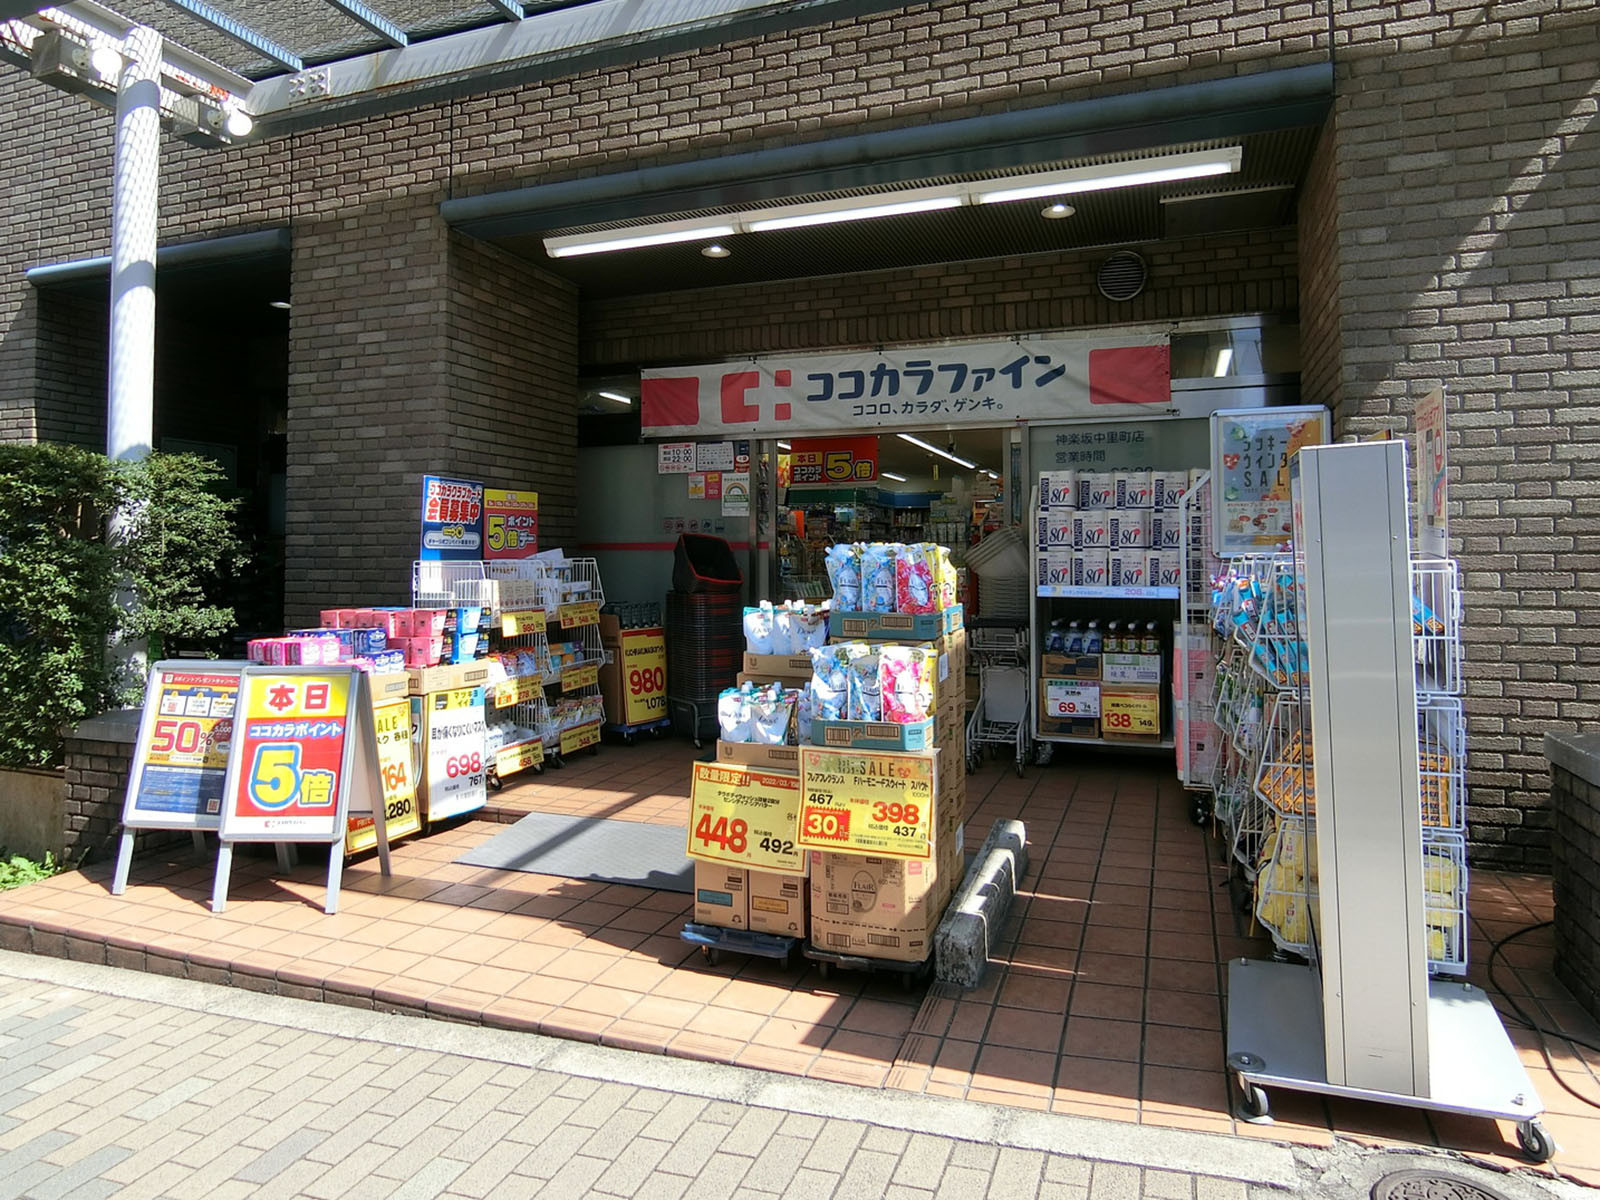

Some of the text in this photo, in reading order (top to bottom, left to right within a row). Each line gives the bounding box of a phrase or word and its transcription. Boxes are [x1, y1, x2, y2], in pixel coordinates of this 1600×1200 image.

[807, 354, 1066, 402] ココカラファイン
[852, 396, 1004, 417] ココロ、カラダ、ゲンキ。
[1055, 431, 1145, 446] 神楽坂中里町店
[796, 454, 818, 463] 本日
[1055, 450, 1106, 464] 営業時間
[1243, 452, 1288, 469] ウィンタ
[793, 465, 822, 474] ココカラ
[825, 450, 875, 481] 5倍
[793, 473, 822, 482] ポイント
[1243, 470, 1285, 487] SAL
[1050, 488, 1067, 503] 80
[1091, 490, 1107, 505] 80
[1127, 490, 1143, 505] 80
[1049, 527, 1065, 543] 80
[1084, 529, 1100, 544] 80
[1121, 529, 1137, 545] 80
[1050, 568, 1065, 584] 80
[1085, 569, 1101, 584] 80
[1122, 569, 1139, 585] 80
[1160, 569, 1178, 584] 80
[629, 666, 665, 696] 980
[268, 683, 330, 711] 本日
[1058, 701, 1076, 713] 69
[377, 715, 398, 734] ALE
[1104, 712, 1132, 728] 138
[250, 721, 343, 737] ココカラポイント
[446, 751, 482, 779] 698
[859, 760, 895, 777] SALE
[250, 743, 335, 810] 5倍
[468, 774, 483, 787] 767
[698, 766, 751, 787] 数量限定!!
[808, 793, 834, 806] 467
[871, 801, 920, 825] 398
[807, 813, 838, 836] 30
[893, 825, 917, 838] 437
[695, 813, 748, 854] 448
[759, 837, 794, 855] 492
